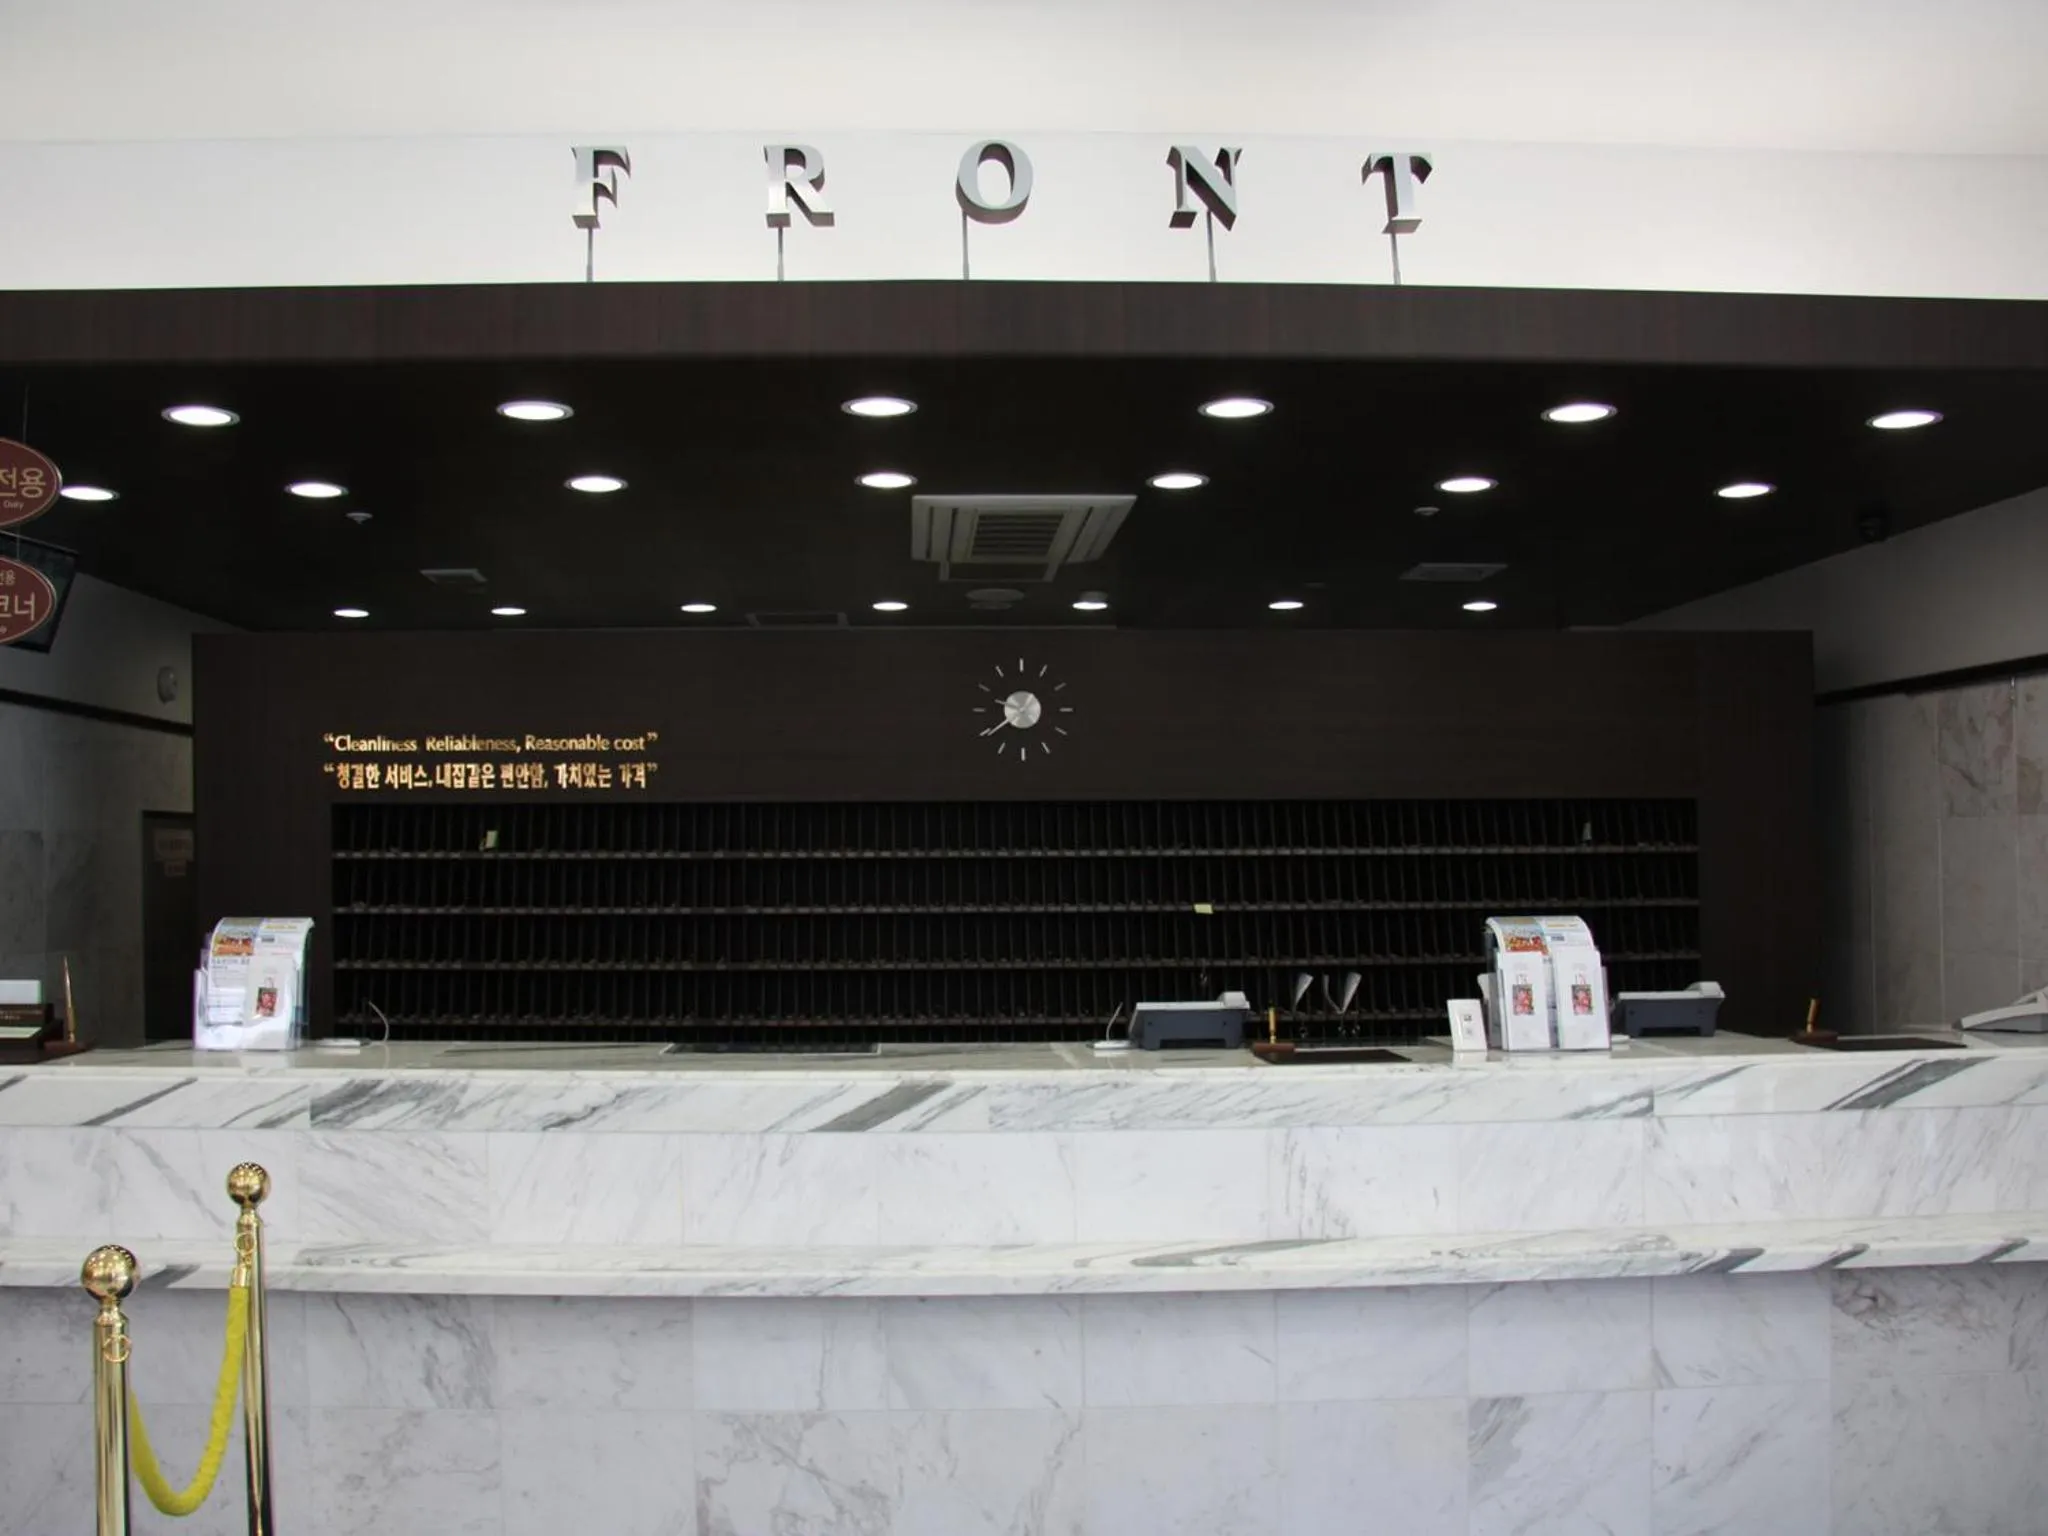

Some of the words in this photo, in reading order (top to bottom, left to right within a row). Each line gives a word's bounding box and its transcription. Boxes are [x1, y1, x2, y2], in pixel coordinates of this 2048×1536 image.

[570, 138, 1434, 234] FRONT
[426, 734, 521, 753] Reliableness,
[525, 734, 610, 751] Reasonable
[436, 762, 496, 789] 내집같은
[553, 762, 612, 789] 가치있는
